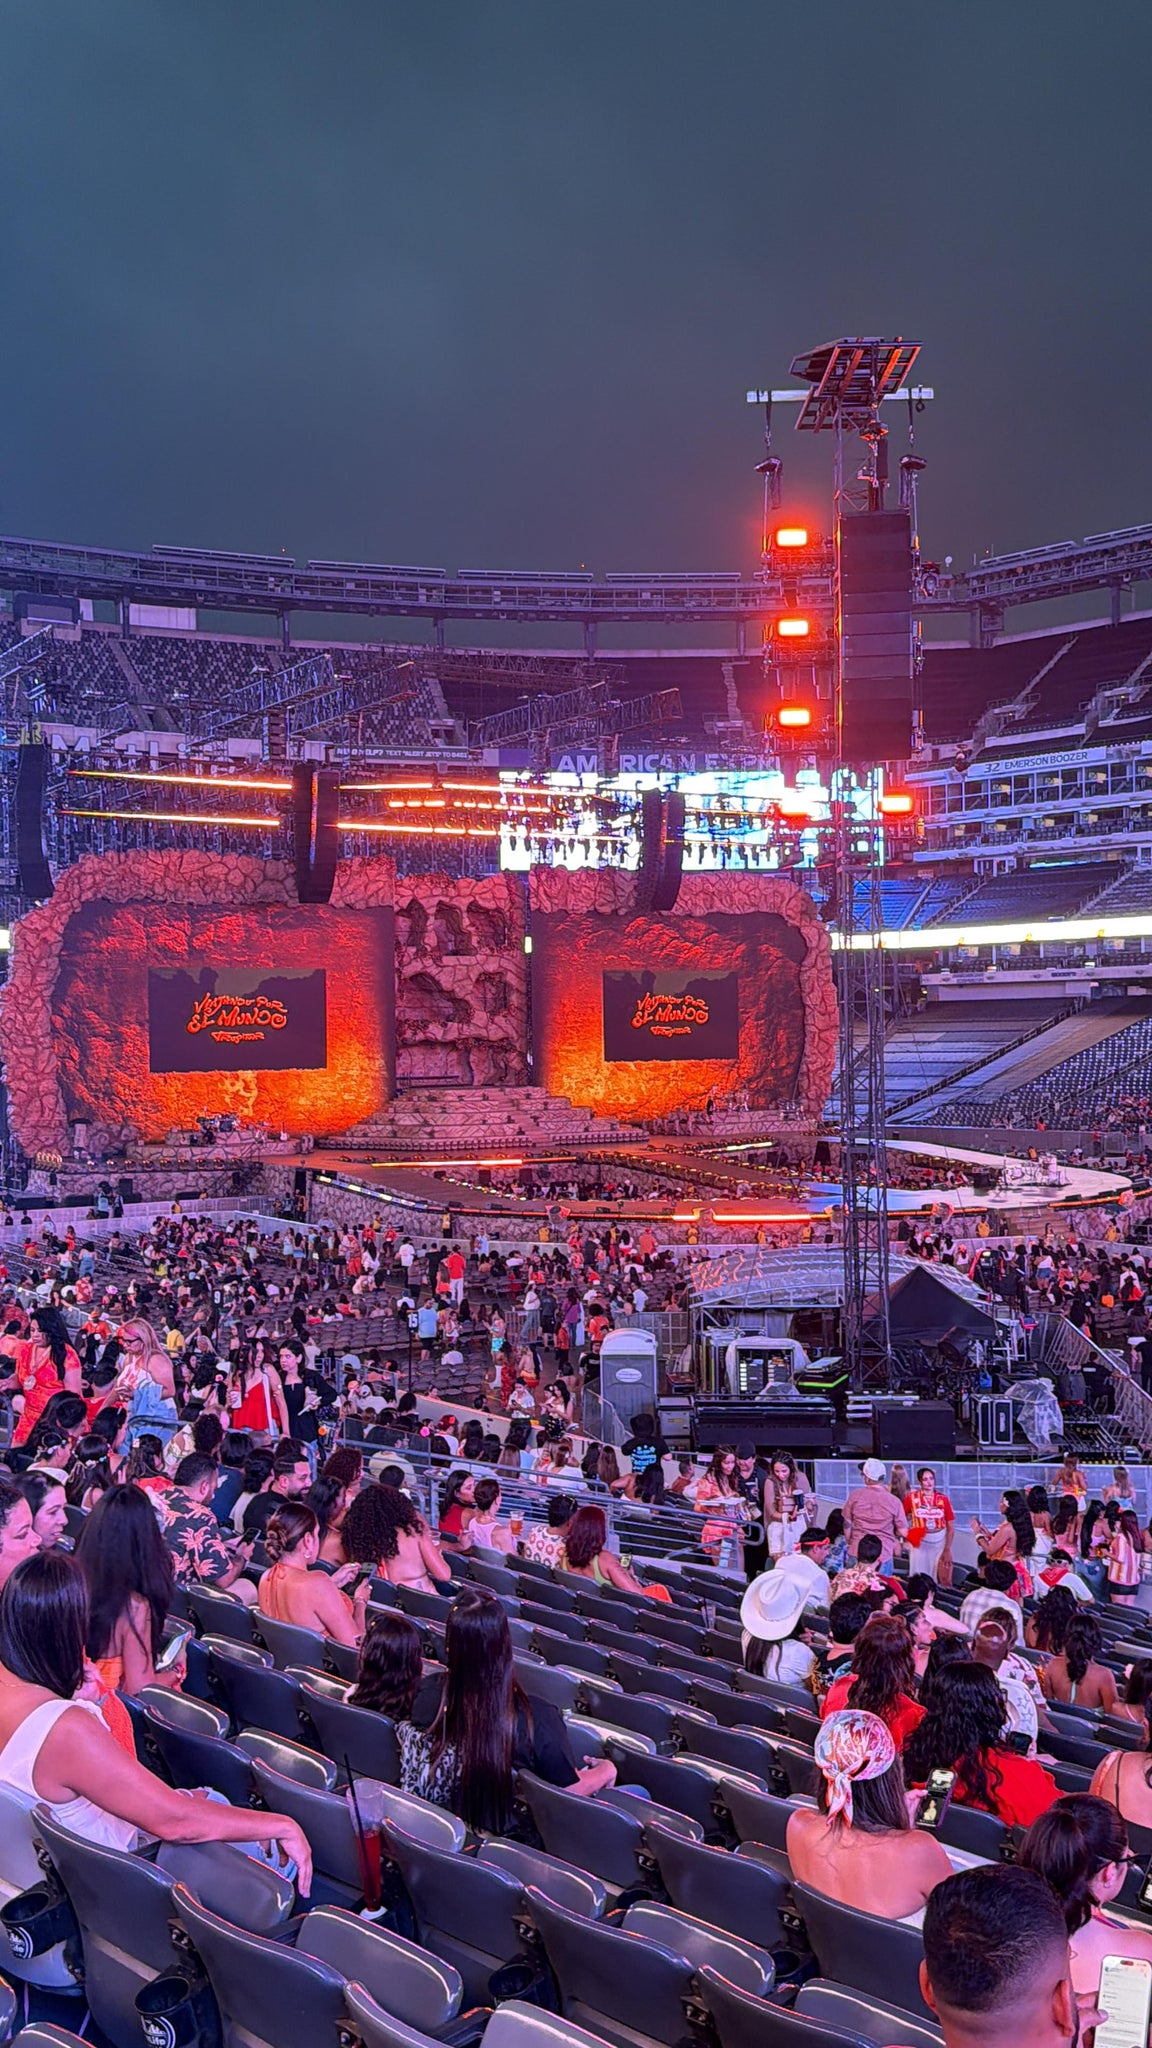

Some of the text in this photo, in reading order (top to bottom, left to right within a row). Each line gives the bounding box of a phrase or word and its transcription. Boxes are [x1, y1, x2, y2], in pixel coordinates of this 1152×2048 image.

[557, 754, 695, 772] AMRICAN
[983, 751, 1088, 774] 32 EMERSON BOOZER
[214, 1290, 221, 1304] 9
[408, 1313, 418, 1328] 15
